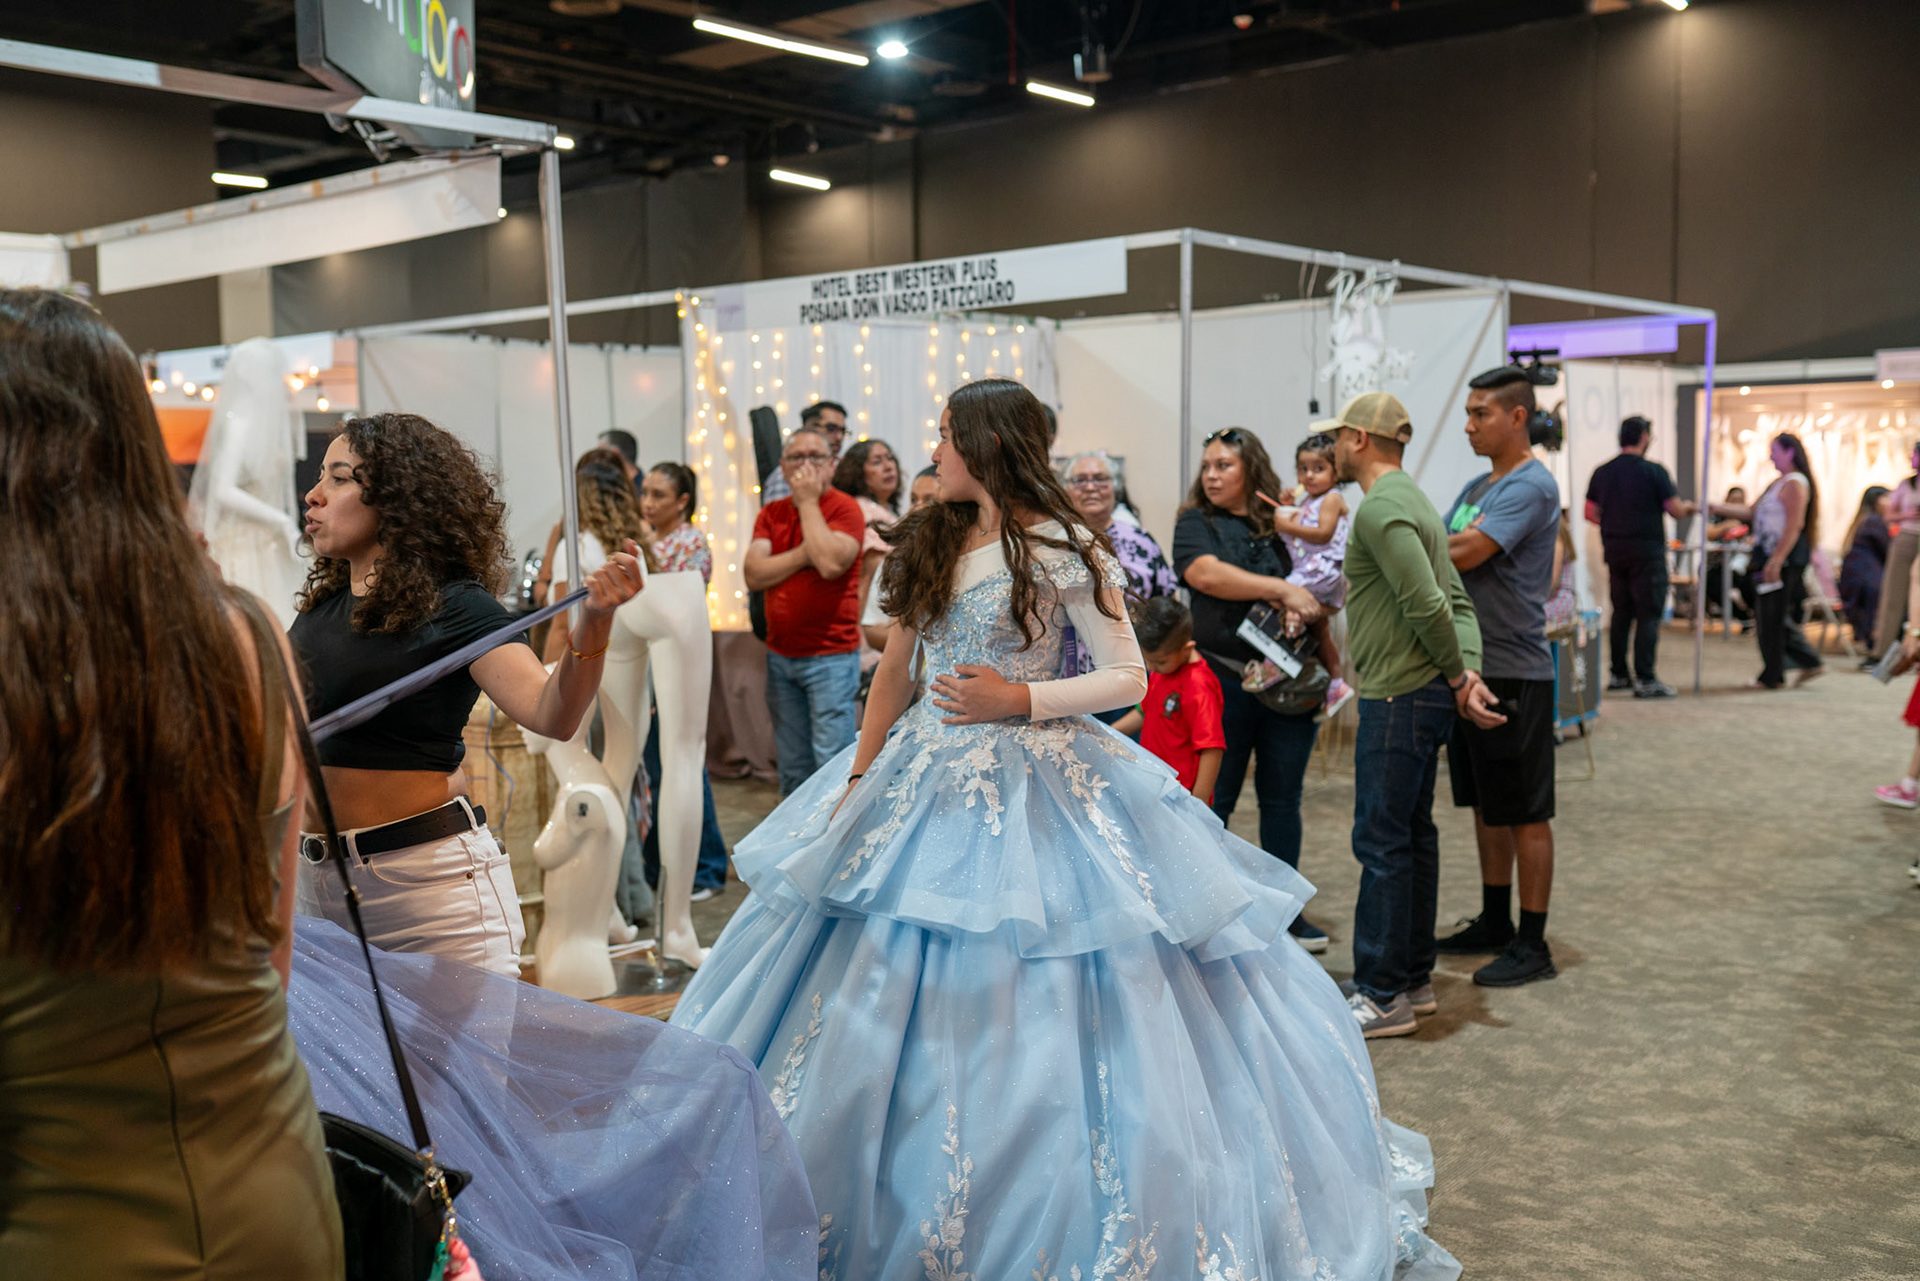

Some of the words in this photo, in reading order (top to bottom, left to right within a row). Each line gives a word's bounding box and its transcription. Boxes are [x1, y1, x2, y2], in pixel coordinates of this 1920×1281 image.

[811, 277, 851, 299] HOTEL
[855, 271, 887, 295] BEST
[892, 264, 956, 289] WESTERN
[962, 258, 997, 282] PLUS
[800, 301, 848, 324] POSADA
[853, 297, 880, 319] DON
[884, 291, 928, 316] VASCO
[932, 280, 1015, 309] PATZCUARO
